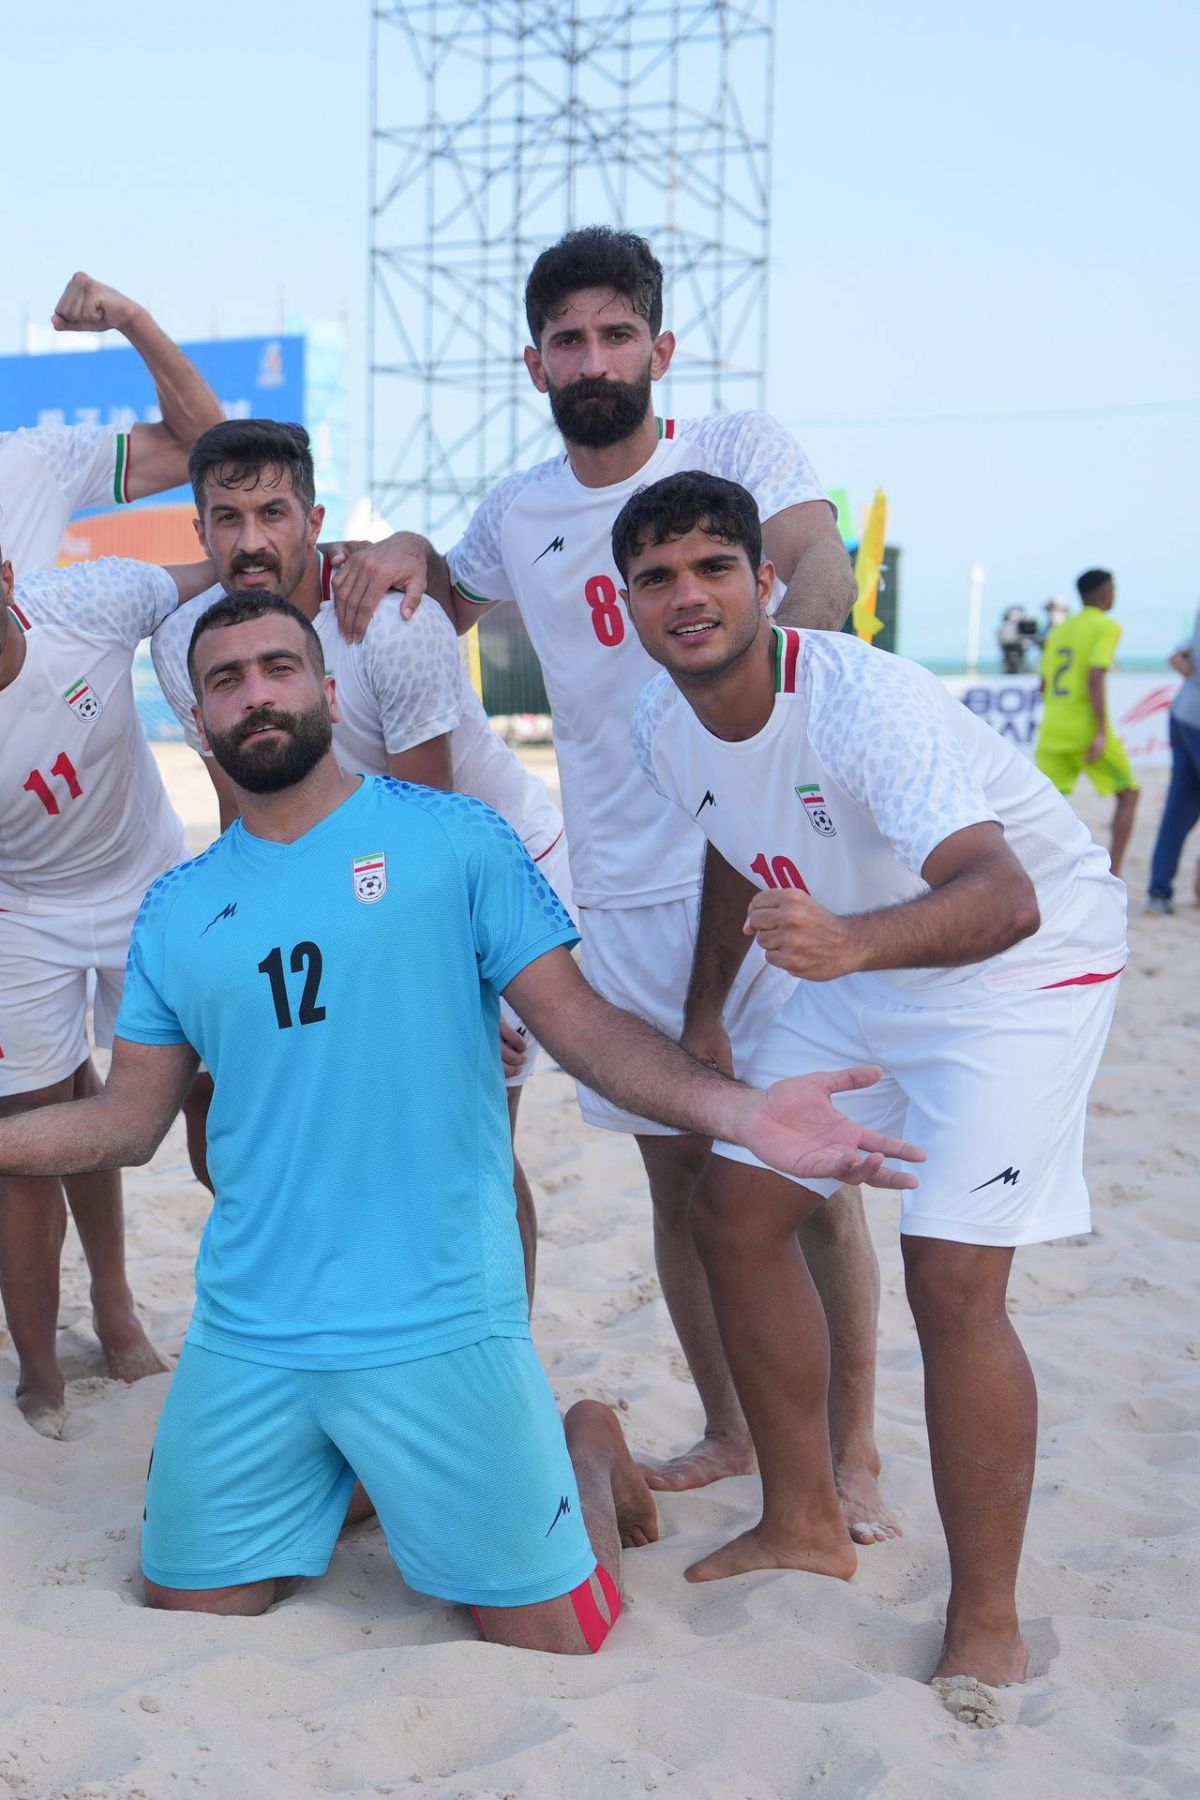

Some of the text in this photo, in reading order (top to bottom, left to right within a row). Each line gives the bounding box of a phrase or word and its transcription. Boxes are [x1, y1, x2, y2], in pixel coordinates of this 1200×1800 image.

[584, 575, 625, 647] 8
[1052, 647, 1073, 696] 2
[23, 751, 84, 816] 11
[258, 940, 326, 1030] 12
